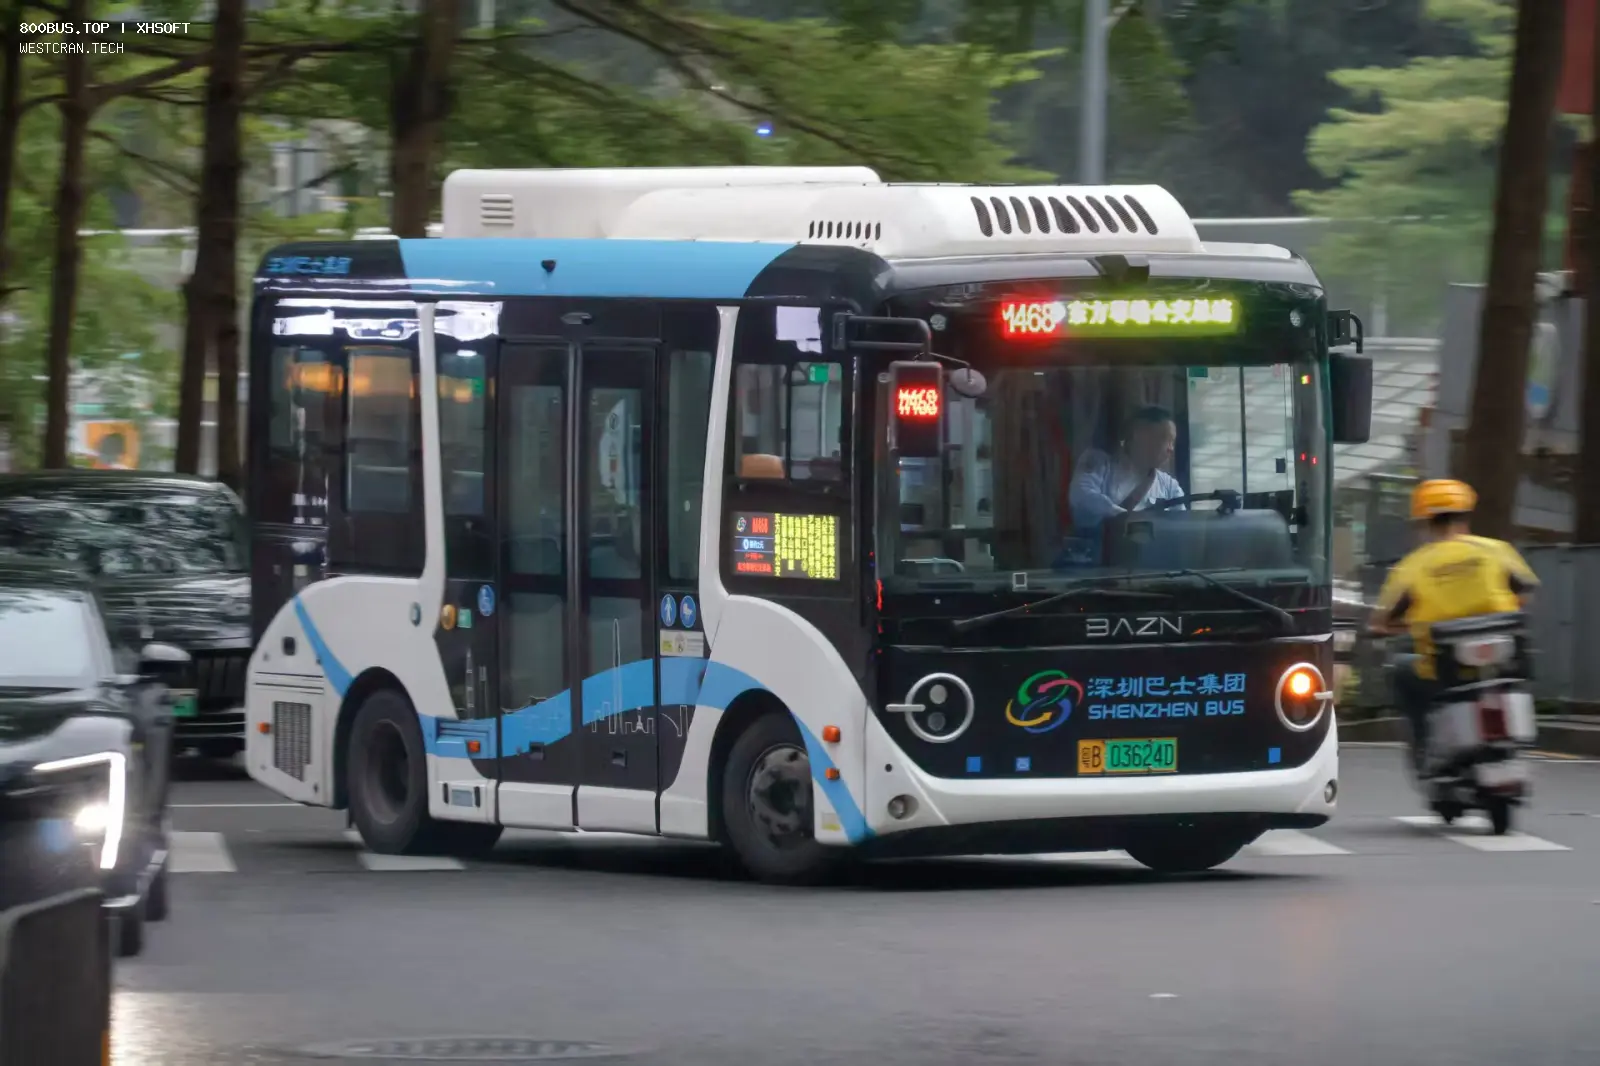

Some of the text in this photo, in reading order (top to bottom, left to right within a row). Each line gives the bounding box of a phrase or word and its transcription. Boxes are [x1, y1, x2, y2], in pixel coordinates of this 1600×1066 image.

[1085, 616, 1183, 637] BAZN
[1087, 673, 1247, 699] 深圳巴士集团
[1088, 699, 1245, 720] SHENZHEN BUS
